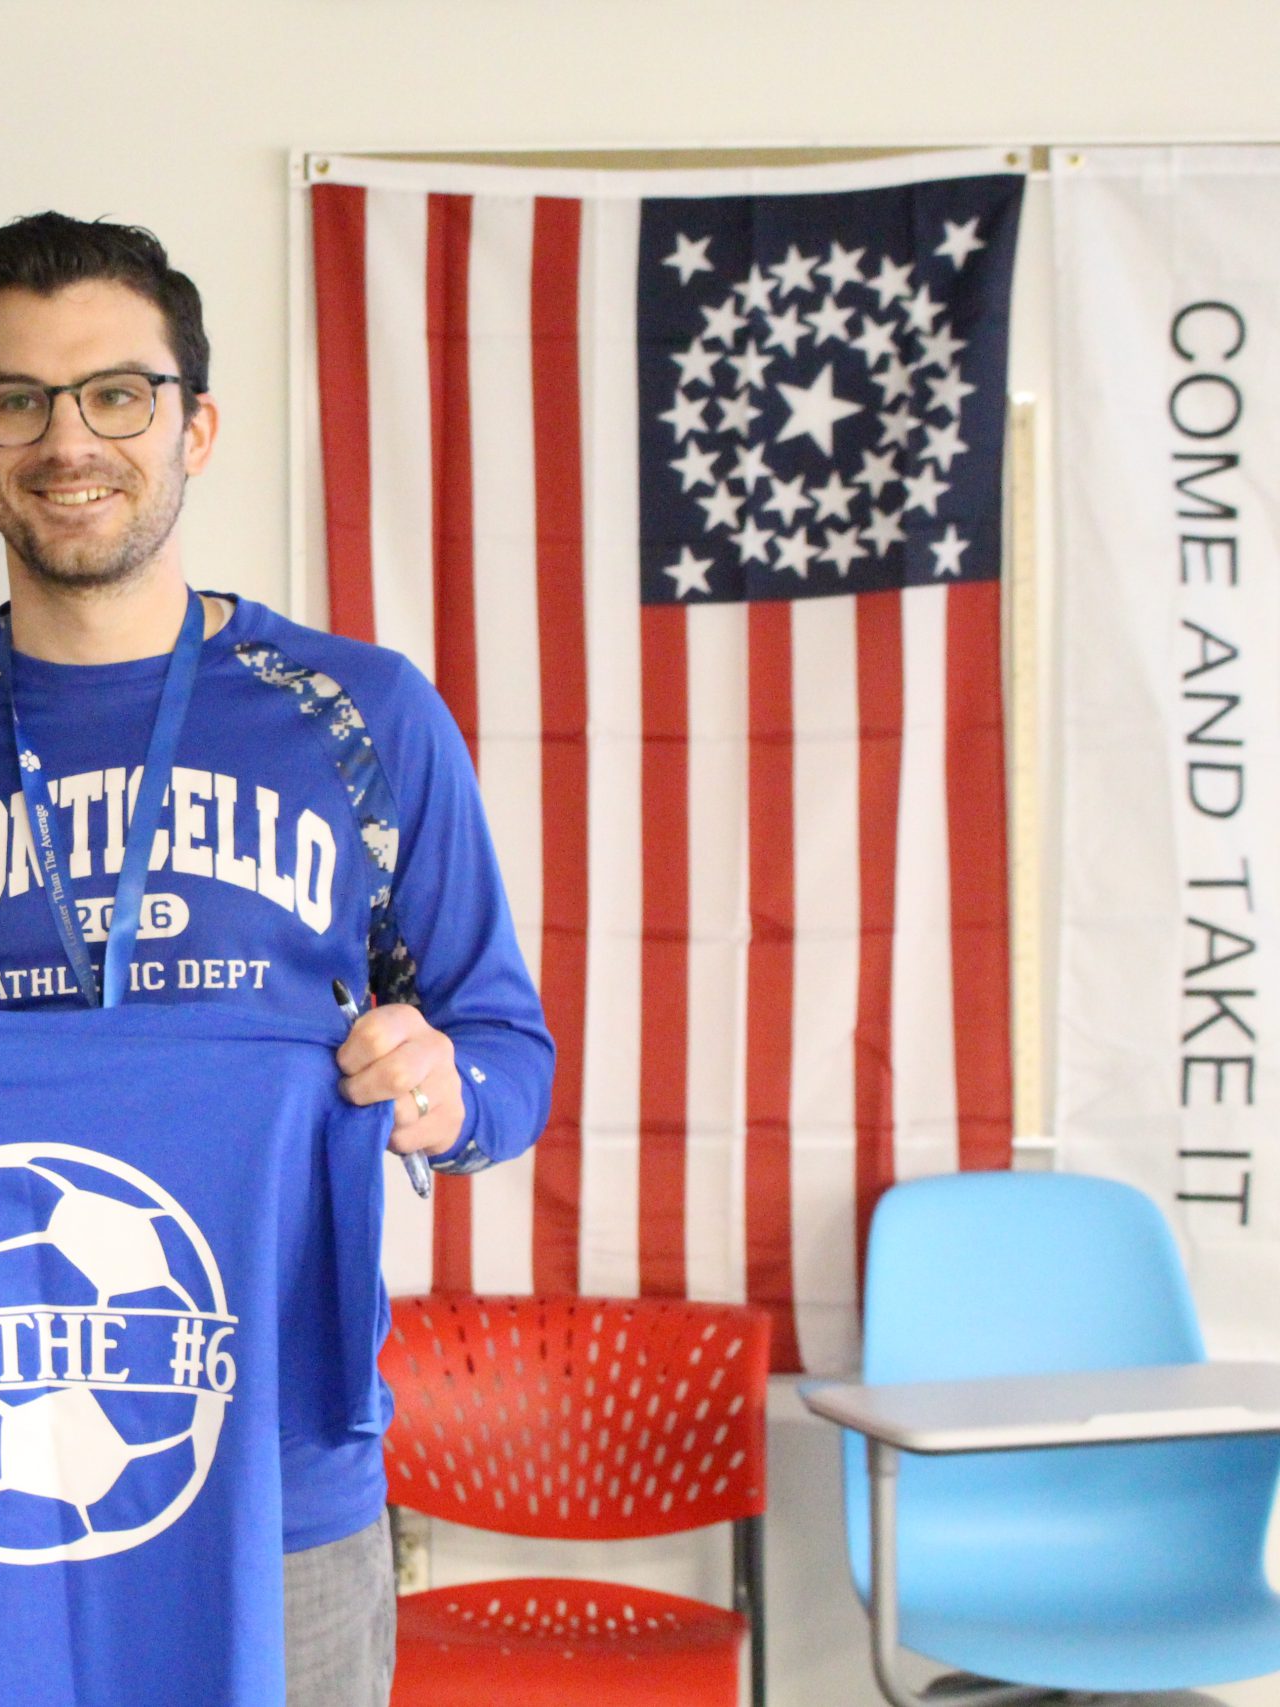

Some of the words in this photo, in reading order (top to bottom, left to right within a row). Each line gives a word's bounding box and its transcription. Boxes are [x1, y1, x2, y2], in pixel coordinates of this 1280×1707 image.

[1169, 301, 1246, 587] COME
[1181, 618, 1245, 819] AND
[35, 804, 53, 848] Average
[44, 849, 58, 872] The
[51, 872, 65, 904] Than
[77, 900, 173, 934] 206
[178, 959, 271, 990] DEPT
[1181, 857, 1257, 1107] TAKE
[1176, 1149, 1252, 1226] IT
[169, 1319, 238, 1394] #6
